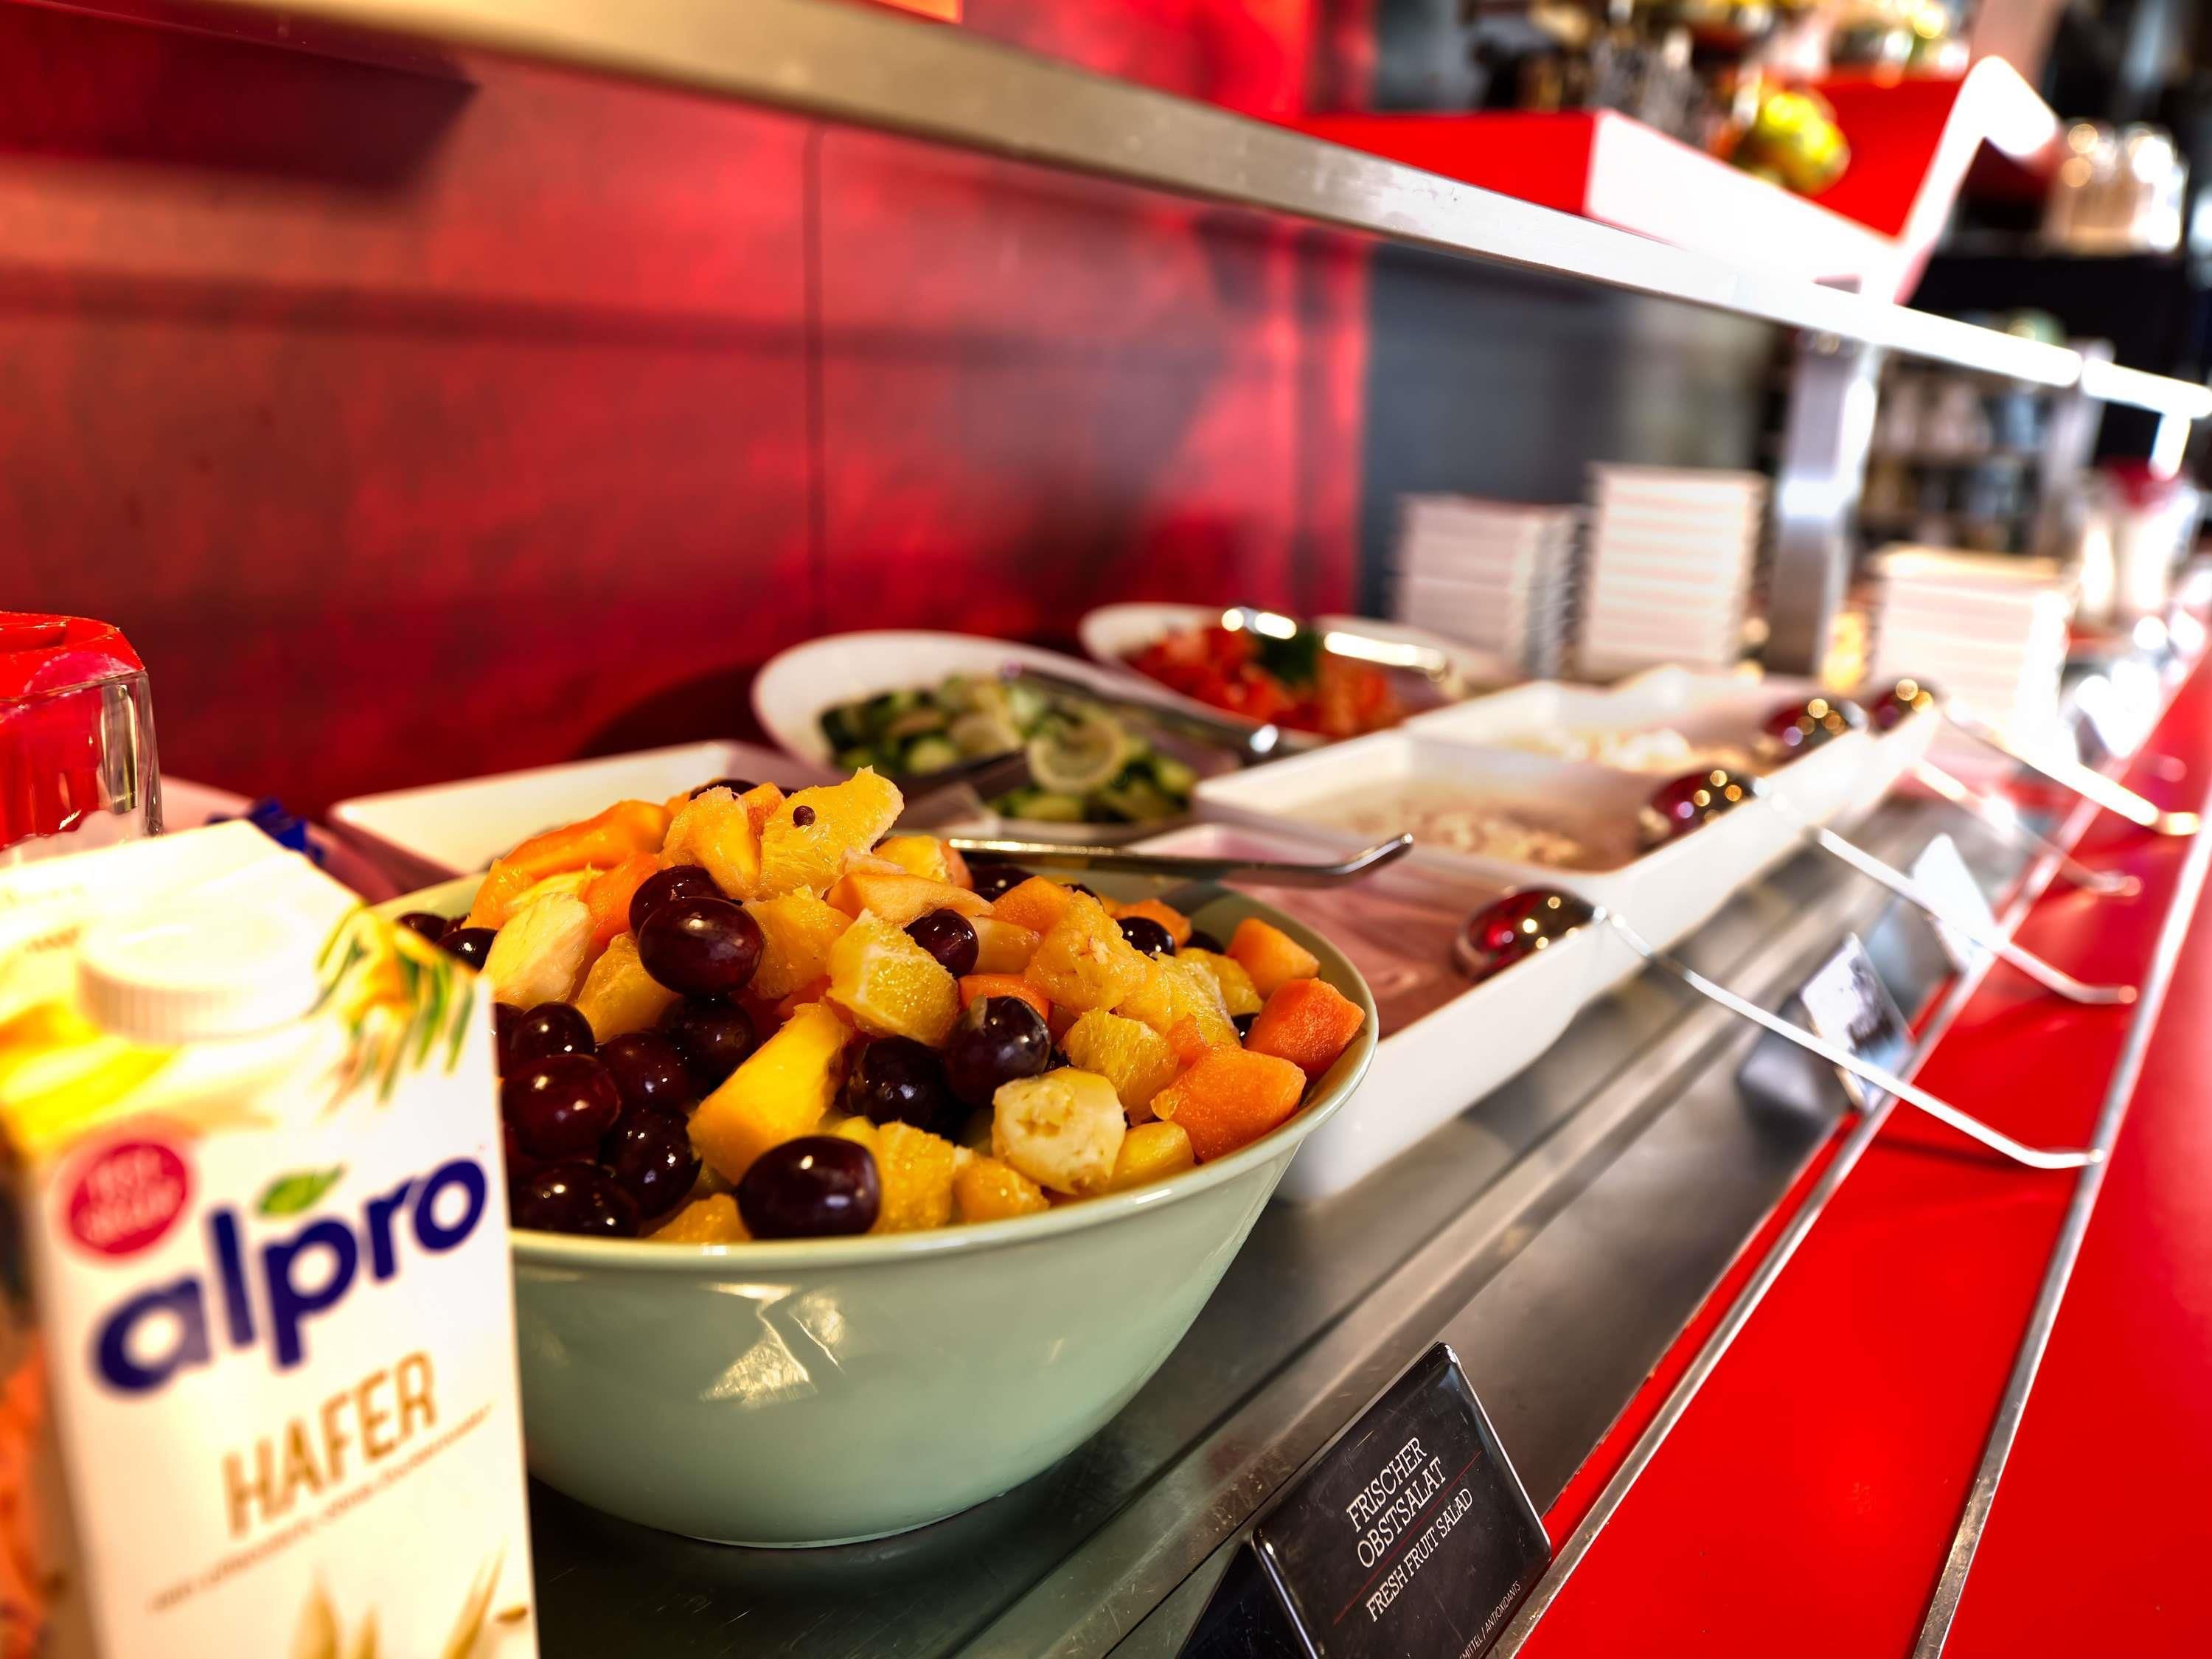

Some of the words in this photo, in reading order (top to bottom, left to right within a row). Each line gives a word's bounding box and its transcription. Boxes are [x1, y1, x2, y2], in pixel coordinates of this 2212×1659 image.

[92, 1157, 487, 1397] alpro
[222, 1351, 438, 1537] HAFER
[1346, 1437, 1427, 1533] FRISCHER
[1357, 1456, 1448, 1568] OBSTSALAT
[1366, 1567, 1409, 1622] FRESH
[1404, 1528, 1441, 1576] FRUIT
[1436, 1488, 1473, 1538] SALAD
[1485, 1580, 1521, 1634] ANTIOXIDANTS
